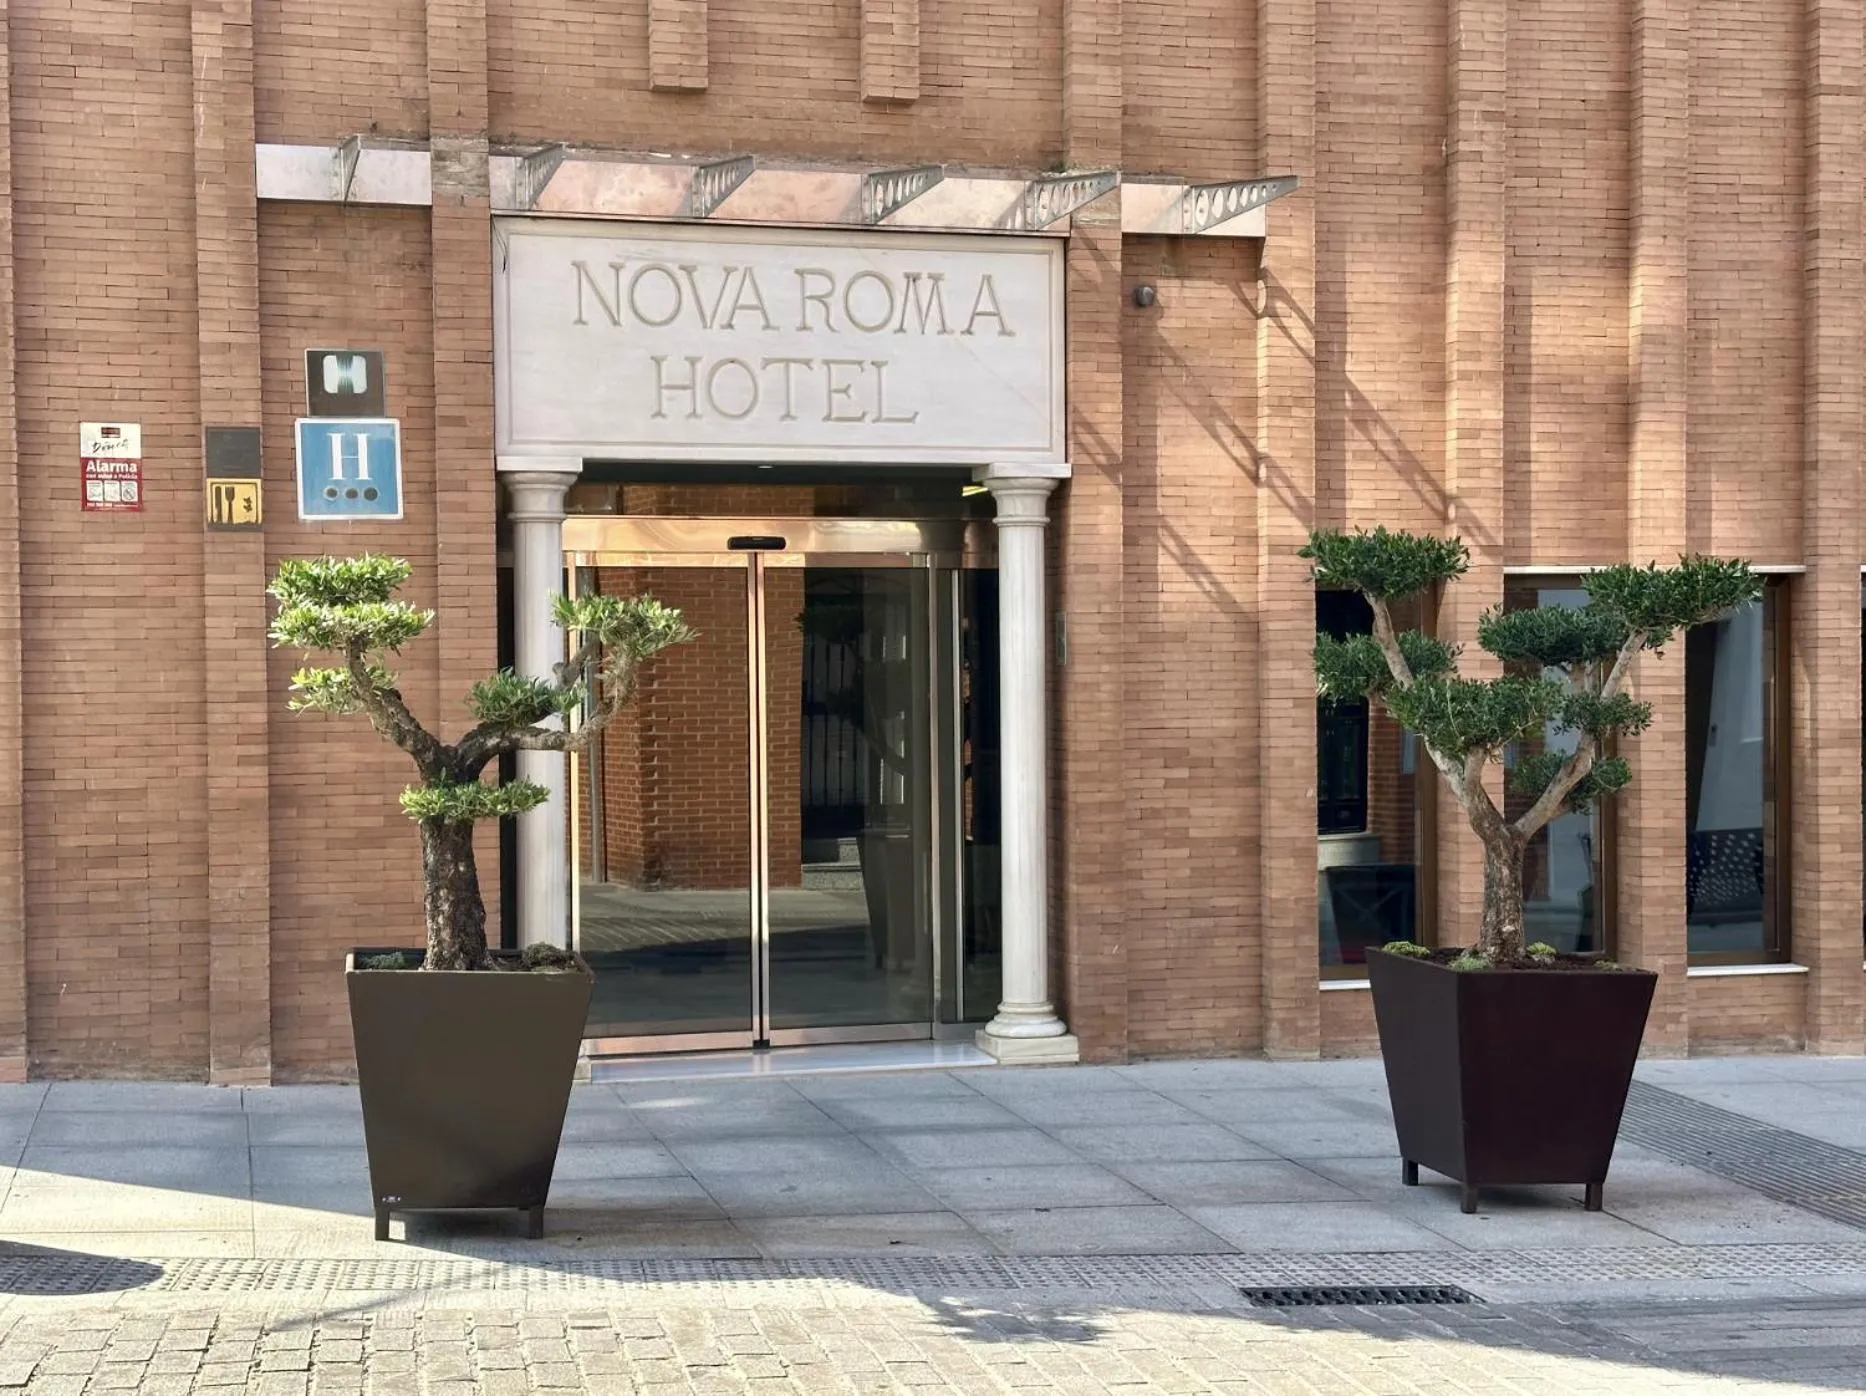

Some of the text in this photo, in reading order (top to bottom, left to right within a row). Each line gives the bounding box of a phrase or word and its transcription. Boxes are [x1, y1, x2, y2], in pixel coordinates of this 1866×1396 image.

[571, 260, 1016, 337] NOVA ROMA
[650, 355, 919, 424] HOTEL
[85, 459, 138, 473] Alarma
[326, 432, 373, 480] H
